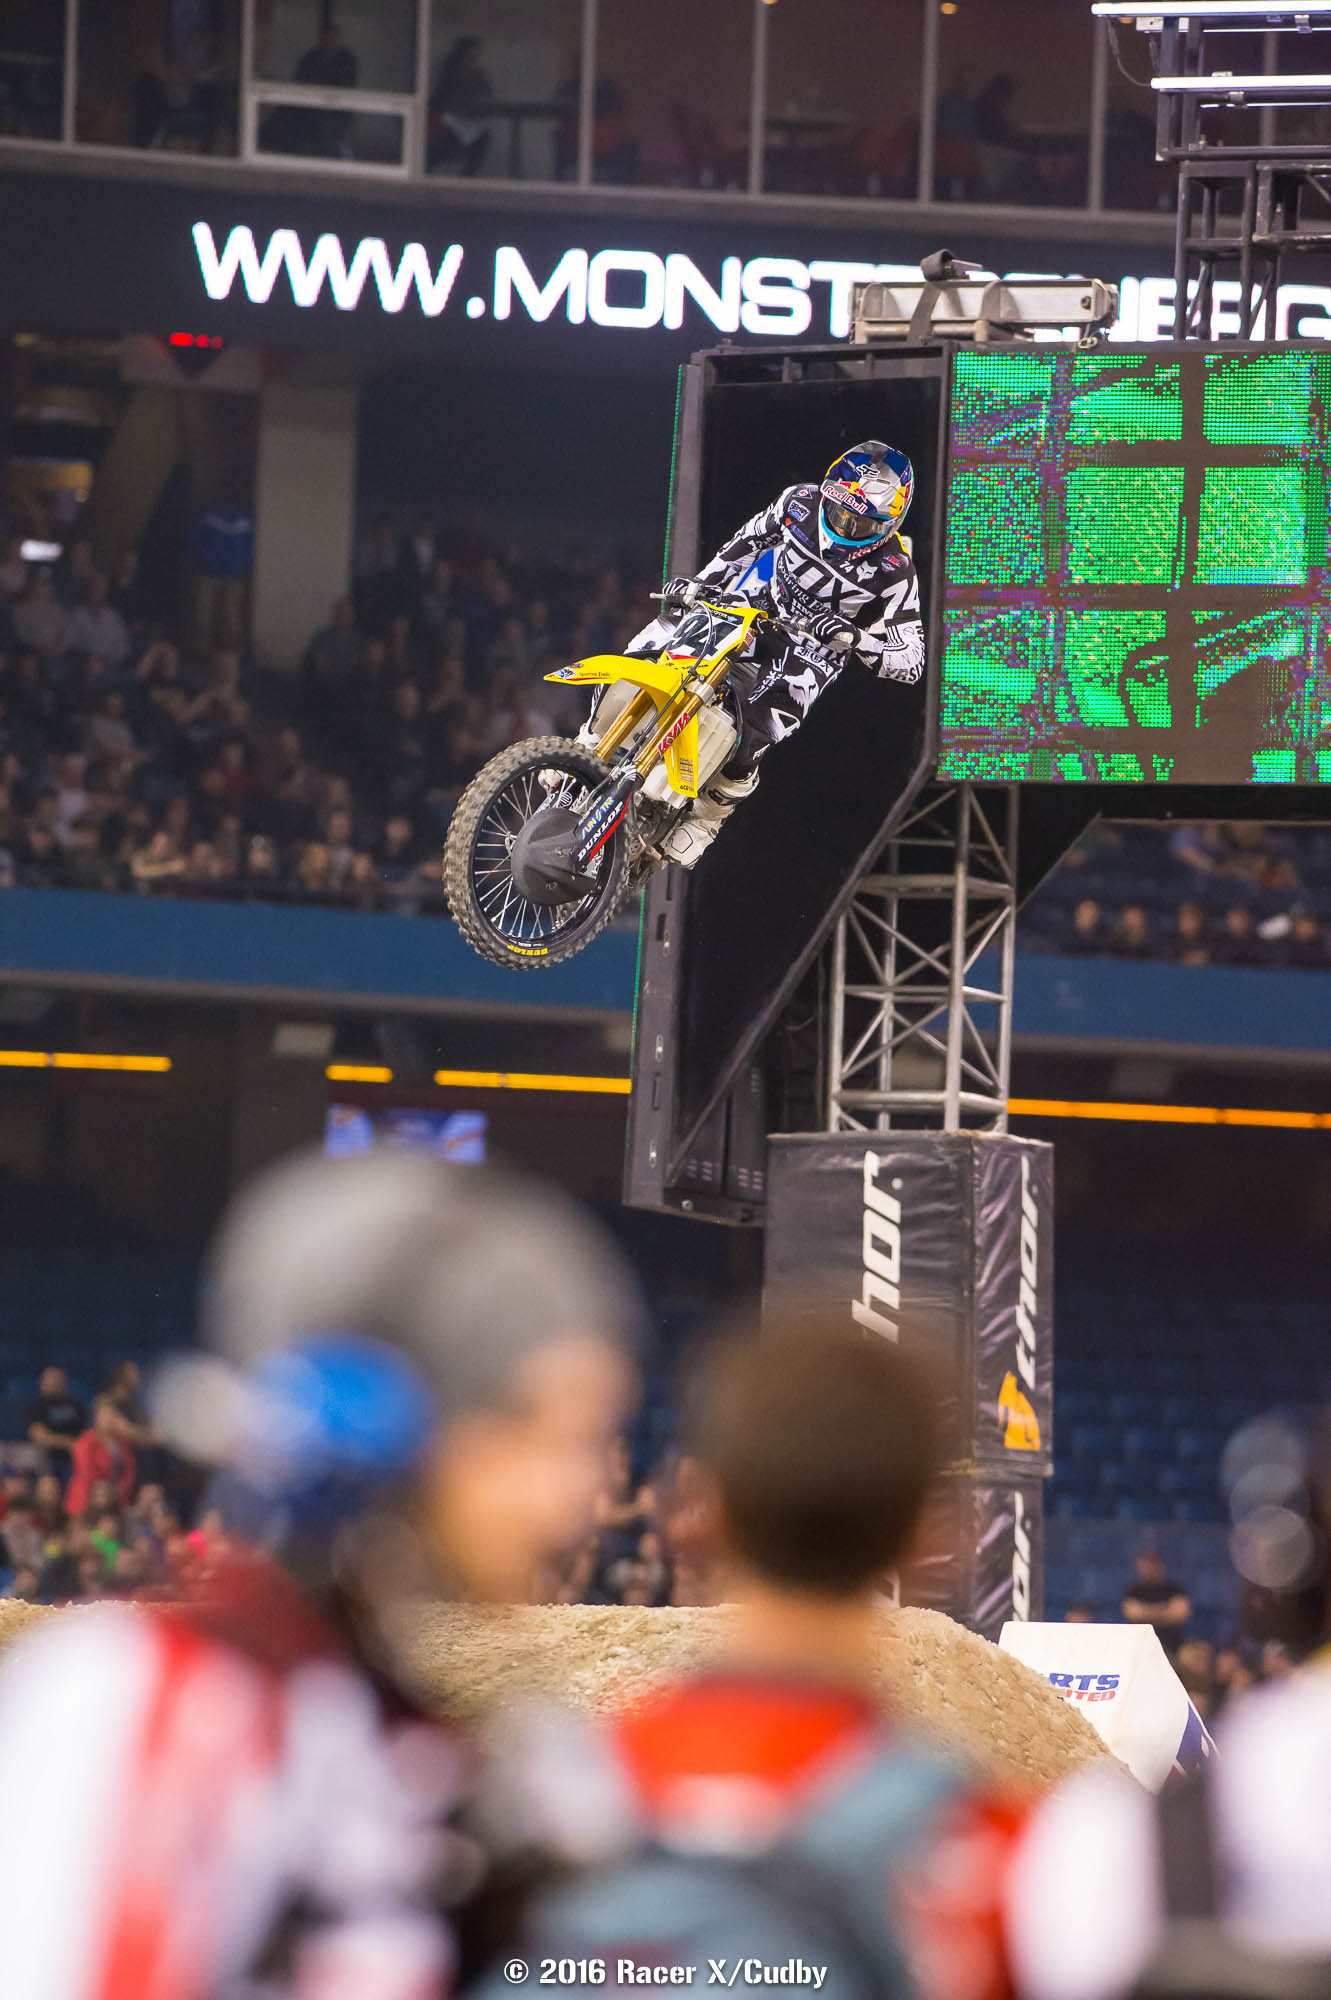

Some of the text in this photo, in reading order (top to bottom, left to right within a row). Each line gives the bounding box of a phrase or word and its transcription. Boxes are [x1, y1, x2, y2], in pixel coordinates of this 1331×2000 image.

[840, 561, 854, 573] 74
[578, 801, 624, 862] DUNLOP
[506, 944, 549, 956] DUNLOP
[851, 1150, 901, 1344] hor
[1046, 1672, 1121, 1691] RTS
[1064, 1689, 1117, 1702] ITED
